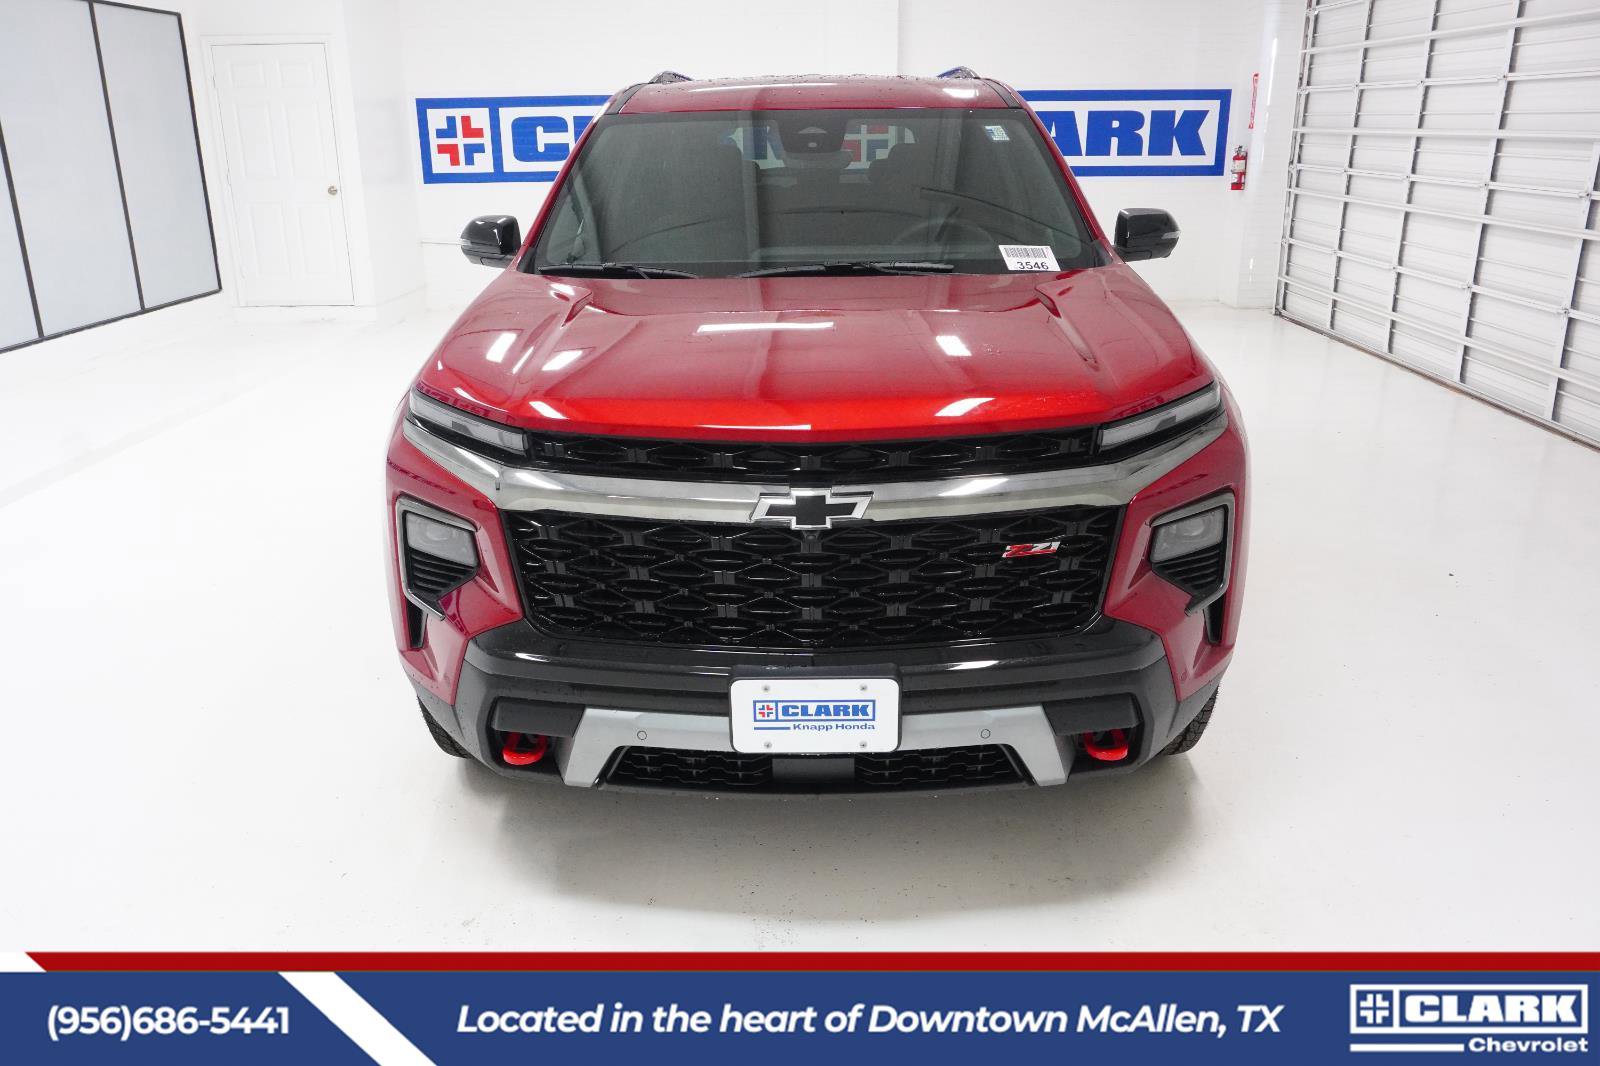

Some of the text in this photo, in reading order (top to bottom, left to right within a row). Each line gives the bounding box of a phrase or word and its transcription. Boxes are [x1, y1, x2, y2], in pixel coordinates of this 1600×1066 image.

[1016, 261, 1050, 271] 3546
[781, 704, 870, 717] CLARK
[792, 722, 876, 733] Knapp Honda
